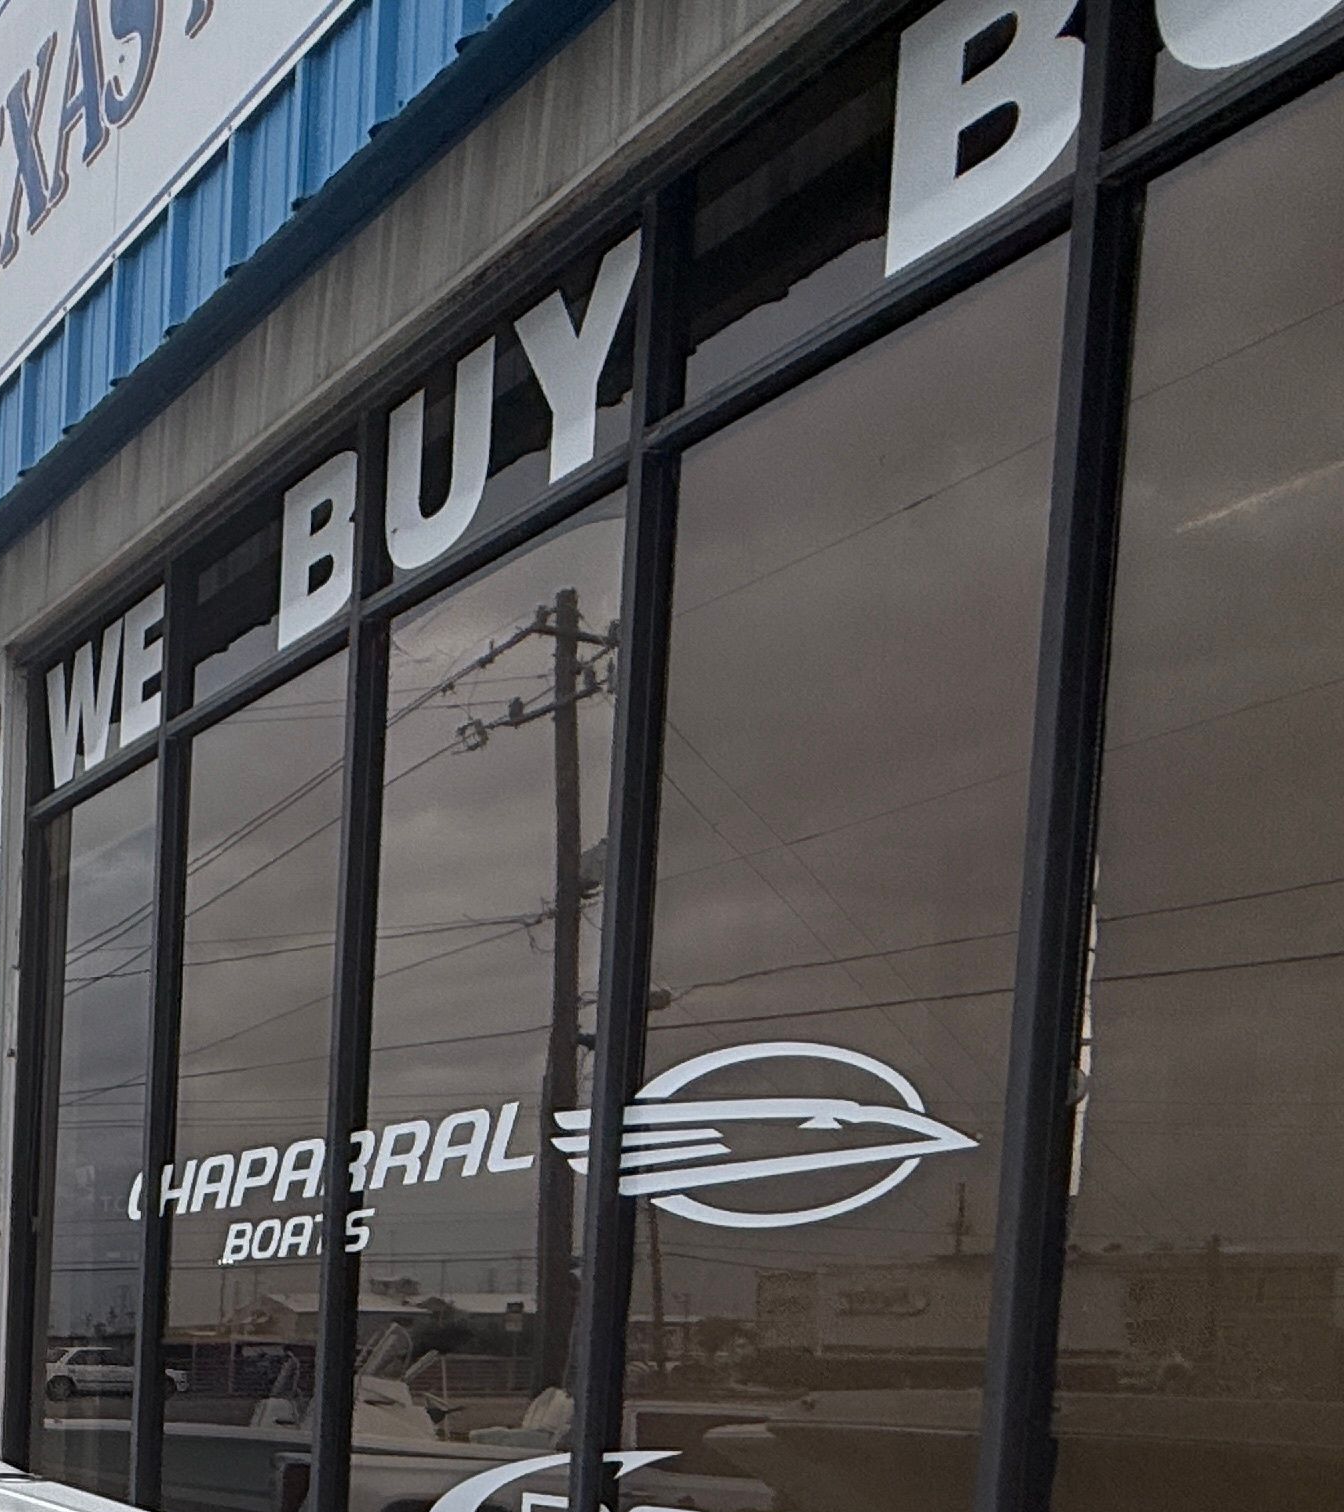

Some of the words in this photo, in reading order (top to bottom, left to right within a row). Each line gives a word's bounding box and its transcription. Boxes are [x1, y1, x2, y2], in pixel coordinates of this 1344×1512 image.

[46, 583, 165, 790] WE
[278, 227, 642, 651] BUY
[885, 0, 1344, 278] B
[224, 1208, 376, 1261] BOATS
